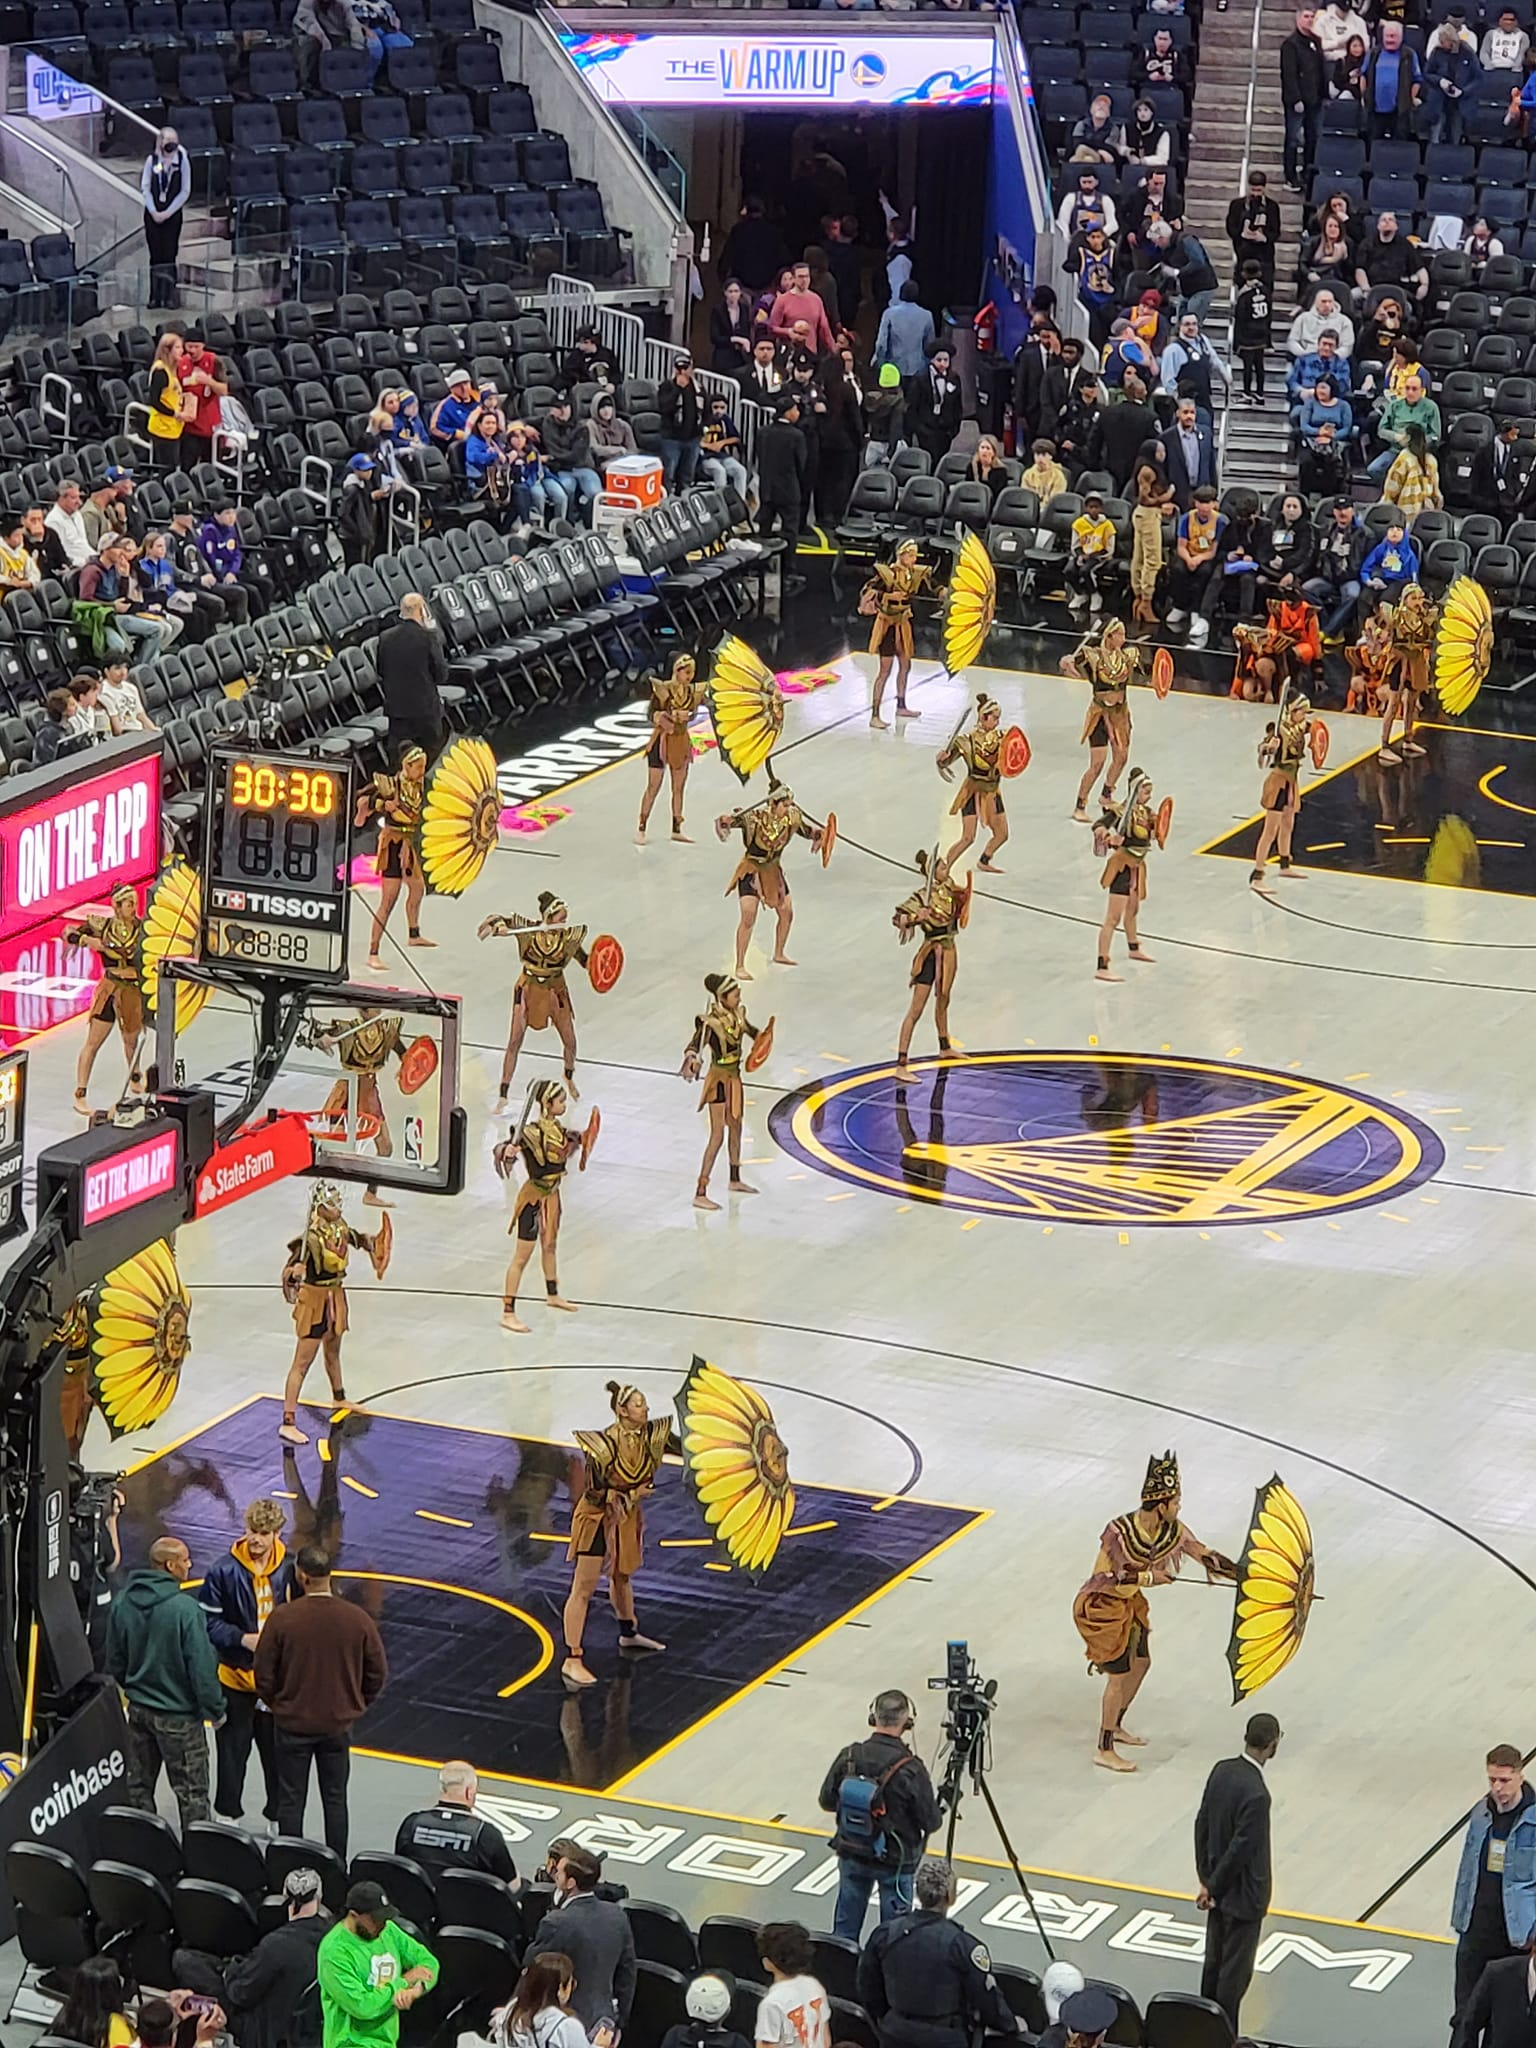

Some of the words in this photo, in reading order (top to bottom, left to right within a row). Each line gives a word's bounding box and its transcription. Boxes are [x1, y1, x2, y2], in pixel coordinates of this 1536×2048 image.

[667, 59, 716, 75] THE
[720, 46, 807, 91] WARM
[812, 49, 845, 91] UP
[1252, 301, 1268, 319] 30
[646, 475, 656, 496] G
[232, 764, 333, 815] 30:30
[18, 820, 51, 907] ON
[54, 800, 100, 891] THE
[102, 781, 148, 872] APP
[246, 891, 337, 922] TISSOT
[87, 1173, 107, 1213] GET
[108, 1163, 128, 1204] THE
[149, 1145, 171, 1186] APP
[29, 1749, 126, 1837] coinbase
[413, 1826, 472, 1853] ESPN
